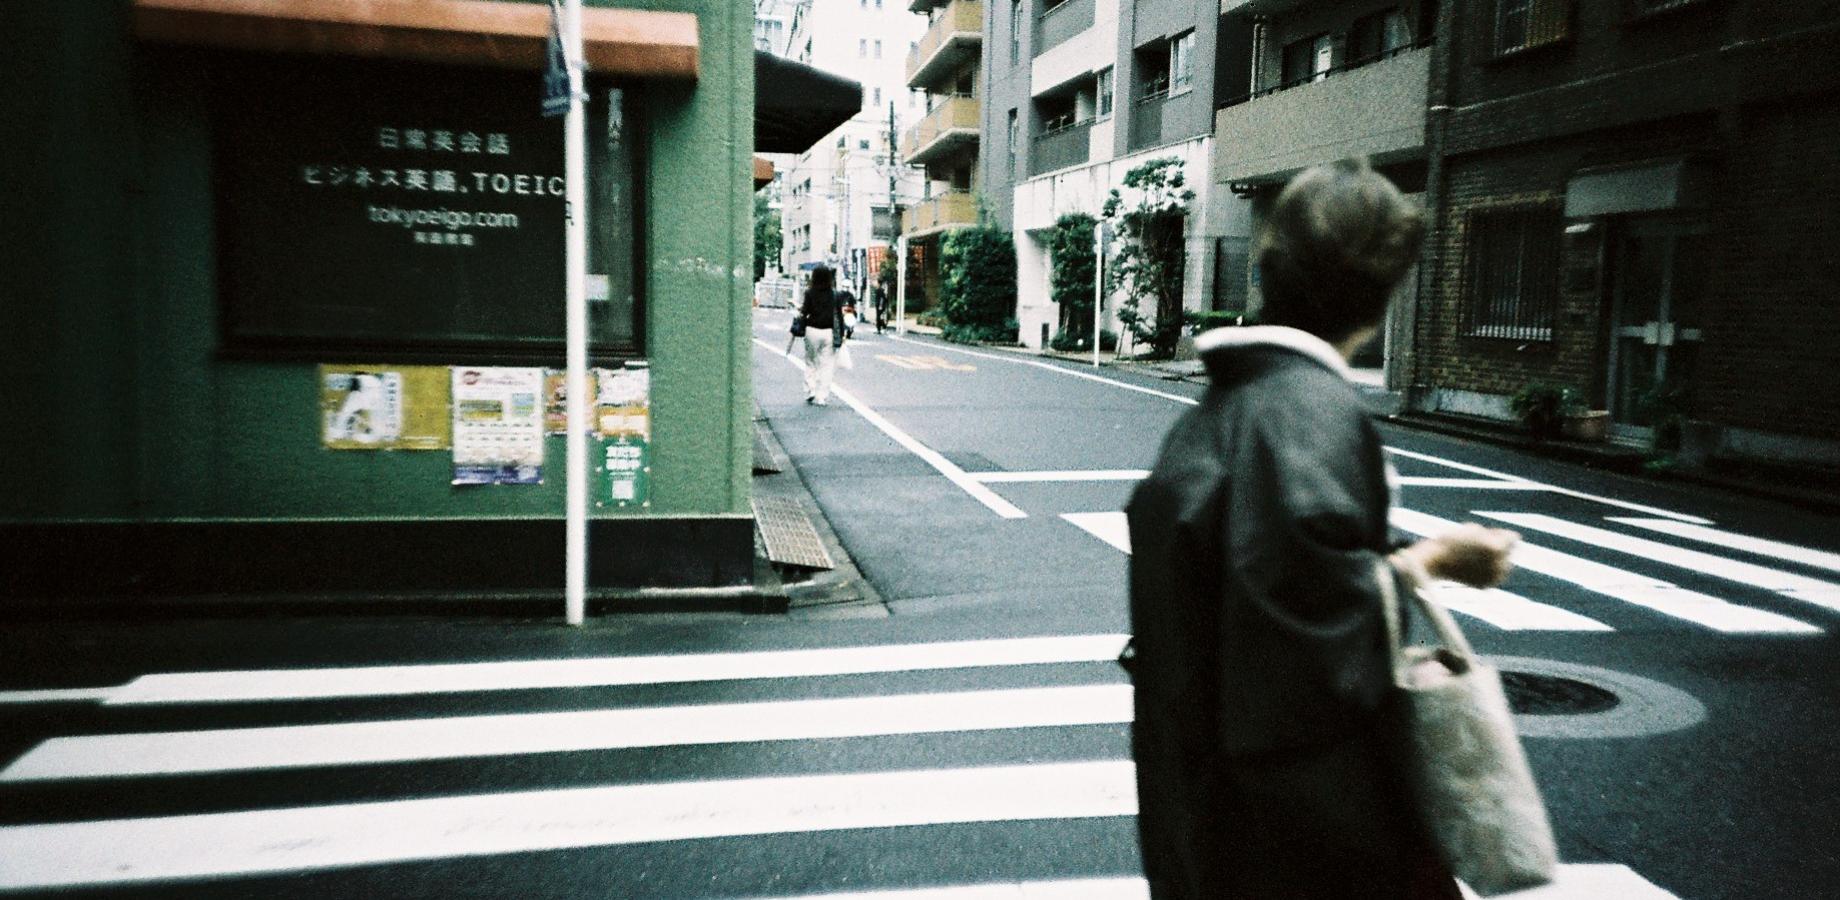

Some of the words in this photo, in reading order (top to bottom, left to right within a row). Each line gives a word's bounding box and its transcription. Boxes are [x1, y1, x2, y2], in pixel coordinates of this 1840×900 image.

[379, 128, 511, 155] 日常英会話
[367, 204, 519, 231] tokyoeigo.com
